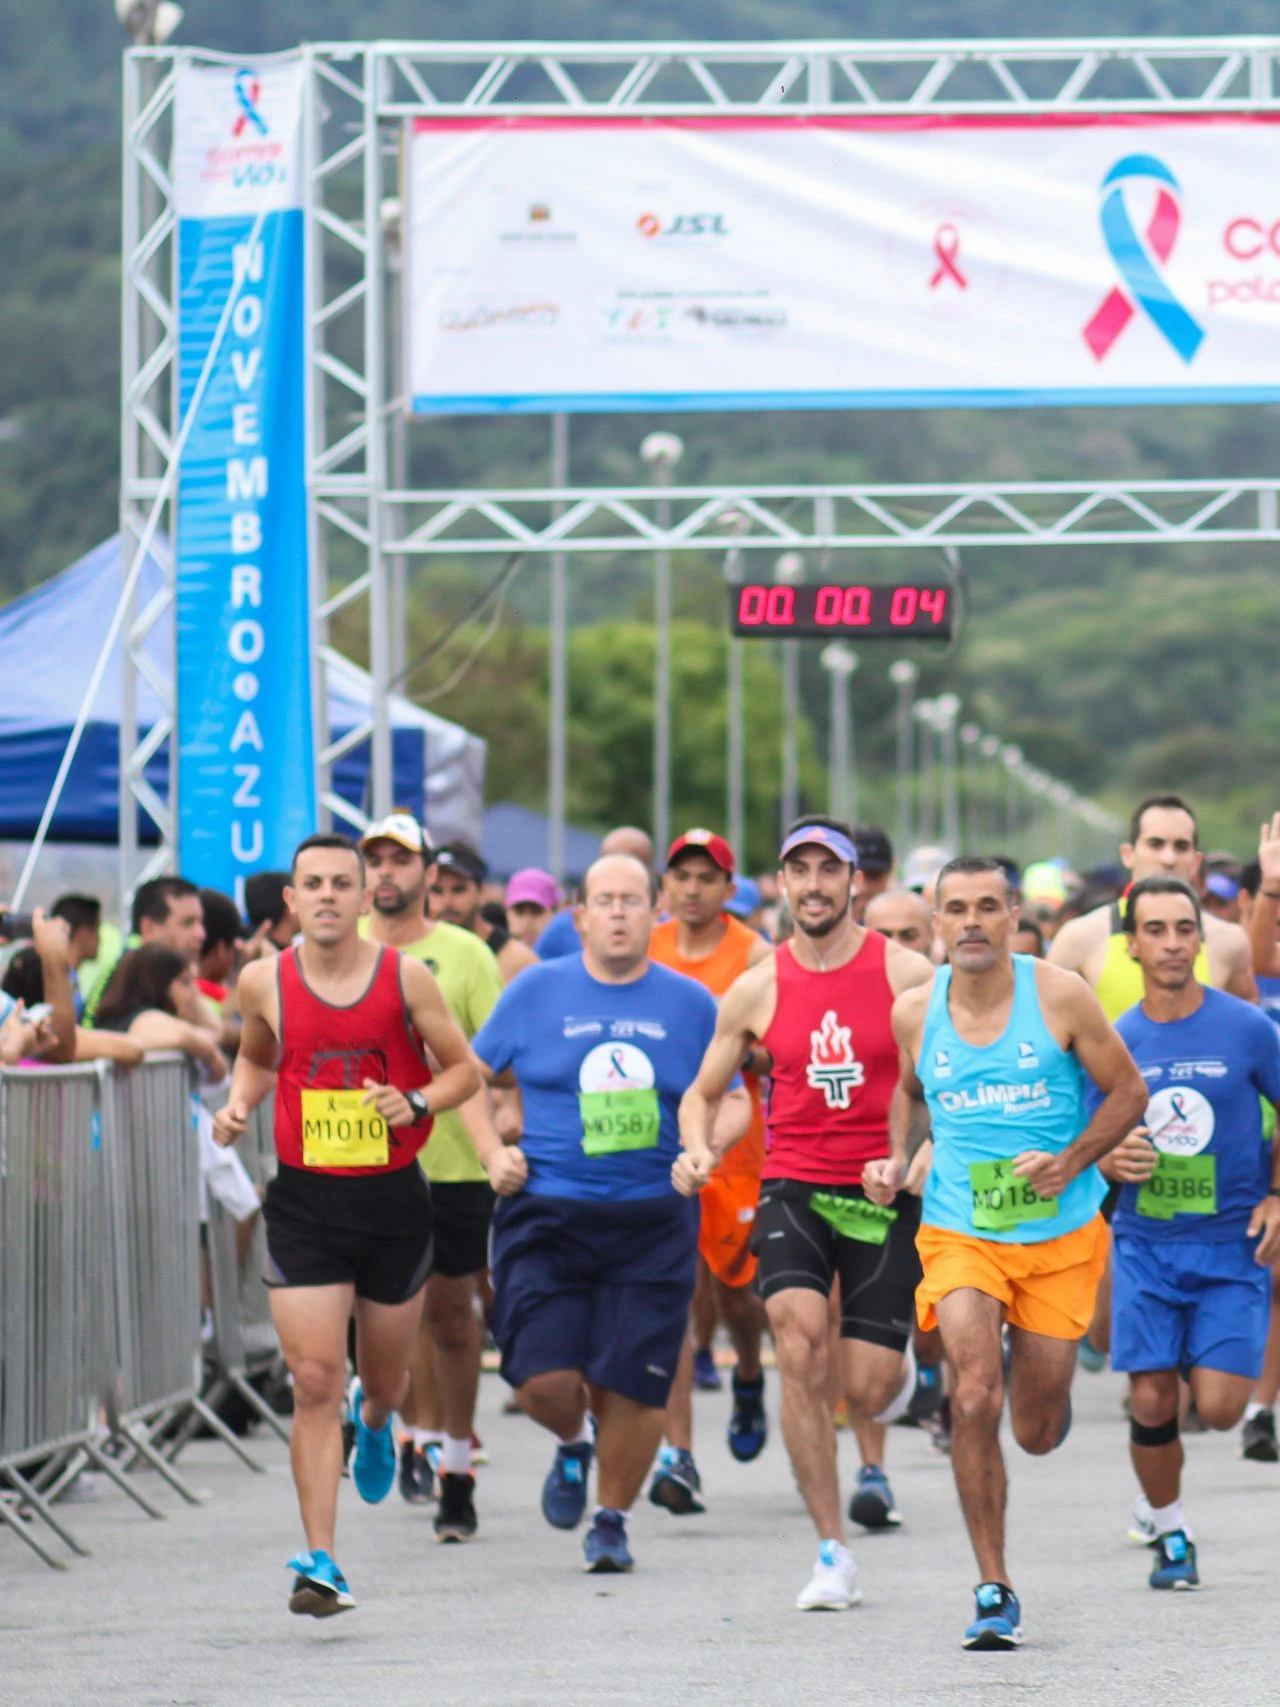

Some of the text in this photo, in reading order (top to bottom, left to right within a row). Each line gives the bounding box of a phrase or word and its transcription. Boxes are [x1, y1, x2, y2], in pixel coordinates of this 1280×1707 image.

[225, 243, 270, 664] NOVEMBRO
[304, 1117, 384, 1141] M1010
[583, 1113, 656, 1137] M0587
[972, 1182, 1055, 1211] M018
